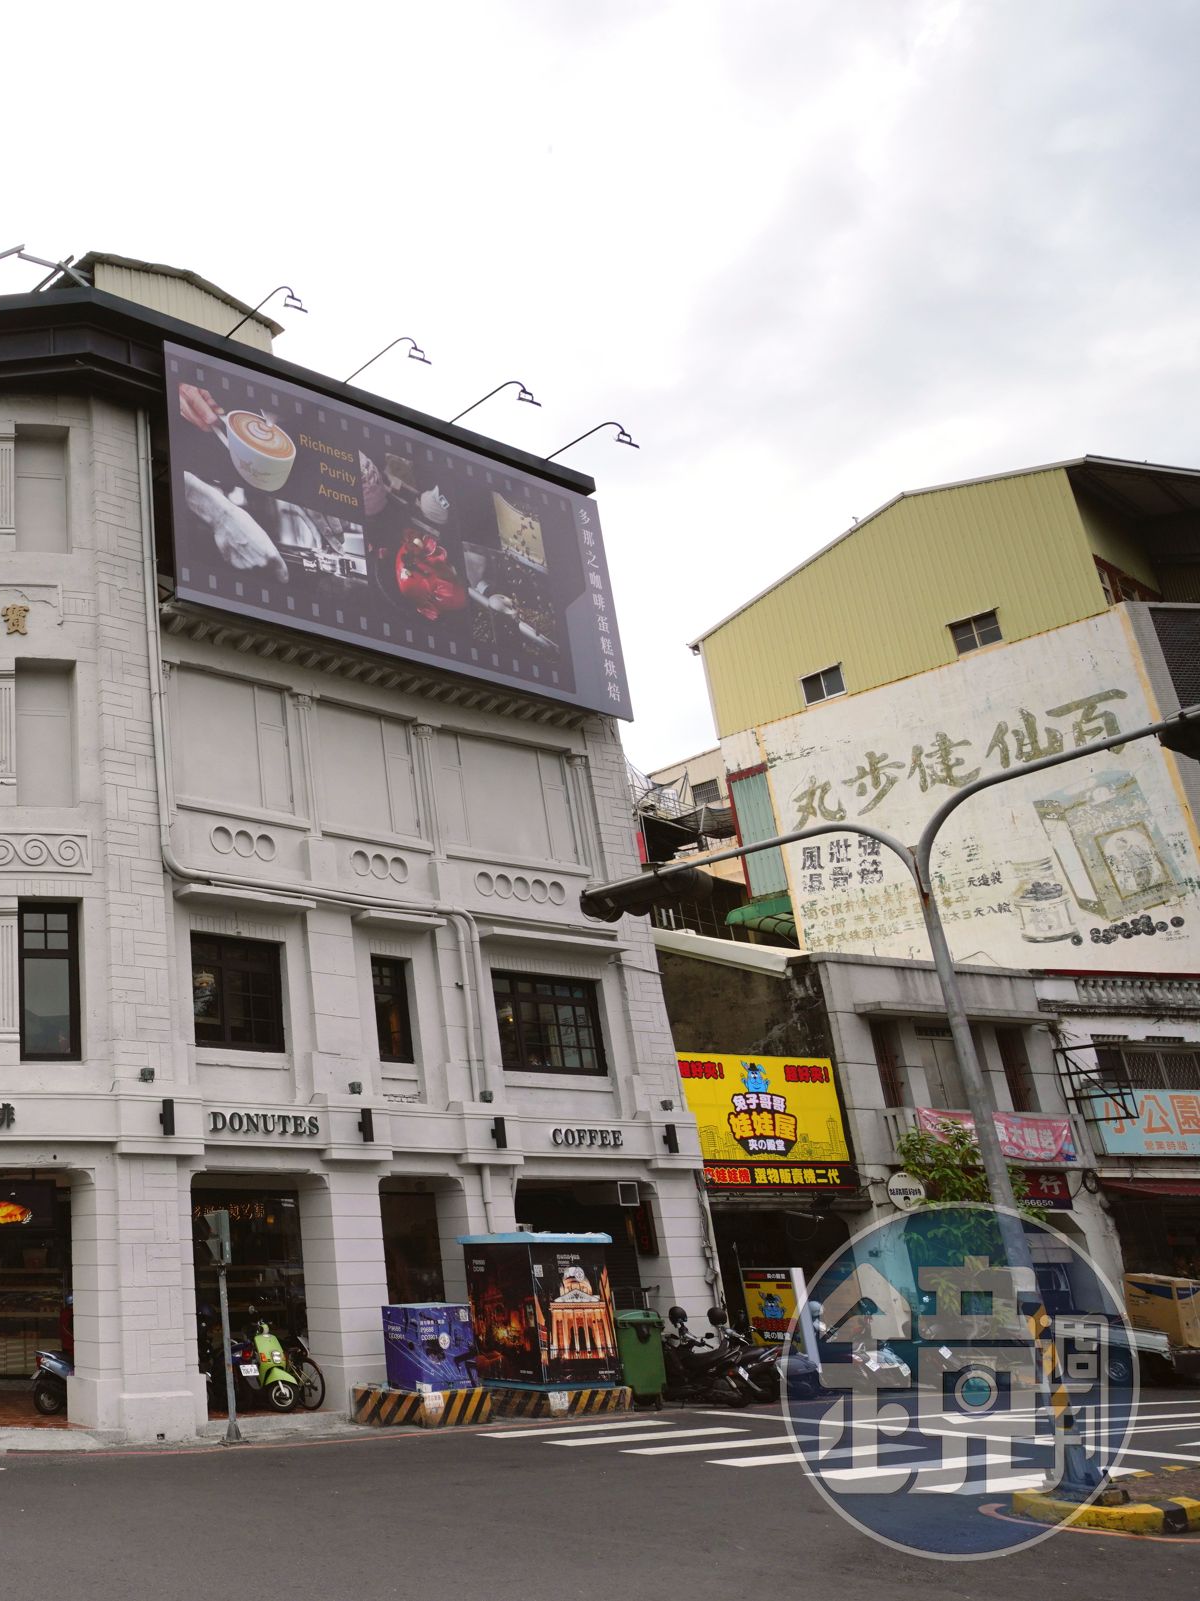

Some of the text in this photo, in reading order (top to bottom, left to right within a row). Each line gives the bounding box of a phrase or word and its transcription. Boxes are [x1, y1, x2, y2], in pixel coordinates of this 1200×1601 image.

[299, 433, 354, 463] Richness
[319, 462, 356, 487] Purity
[318, 484, 359, 507] Aroma
[578, 508, 621, 703] 多那之咖啡蛋糕烘焙
[732, 1093, 786, 1112] 兔子哥哥
[209, 1110, 320, 1136] DONUTES
[728, 1111, 798, 1141] 娃娃屋
[552, 1128, 624, 1148] COFFEE
[754, 1168, 841, 1185] 選物販賣機二代
